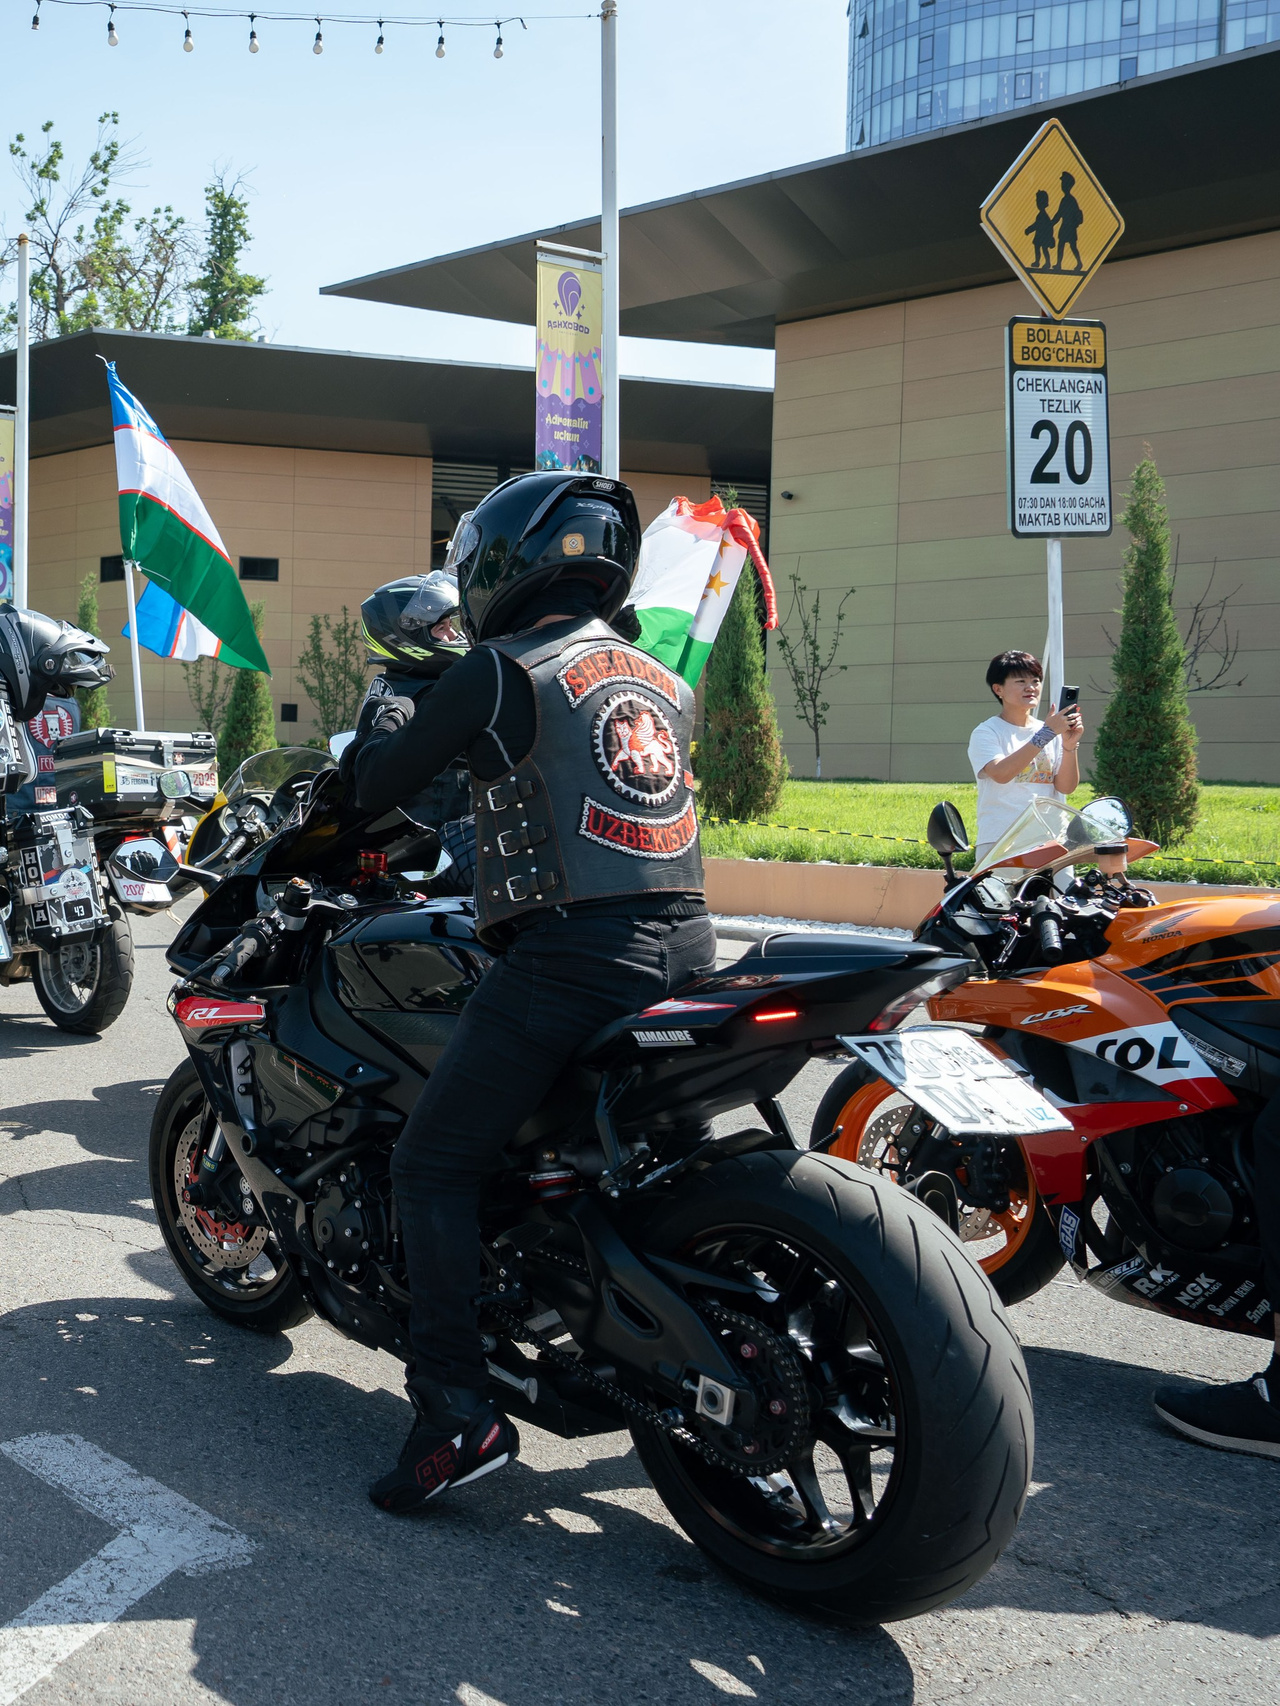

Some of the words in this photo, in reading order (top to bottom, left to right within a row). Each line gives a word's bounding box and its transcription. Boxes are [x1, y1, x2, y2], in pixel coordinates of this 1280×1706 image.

[1026, 327, 1091, 347] BOLALAR
[1017, 376, 1103, 395] CHEKLANGAN
[1040, 399, 1082, 414] TEZLIK
[1030, 419, 1093, 486] 20
[595, 481, 613, 490] SHOEI
[1018, 497, 1039, 509] 07:30
[1040, 497, 1057, 509] DAN
[1058, 496, 1077, 509] 18:00
[1078, 496, 1106, 508] GACHA
[1018, 512, 1062, 527] MAKTAB
[1063, 511, 1107, 527] KUNLARI
[40, 757, 55, 770] FER
[74, 905, 85, 917] 43
[1142, 930, 1183, 945] HONDA
[187, 1007, 220, 1021] R1
[1020, 1004, 1094, 1025] CBR
[632, 1030, 694, 1043] YAMALUBE
[1026, 1107, 1055, 1121] UZ
[1061, 1212, 1077, 1249] GAS
[1132, 1262, 1174, 1295] RK
[1175, 1272, 1217, 1306] NGK
